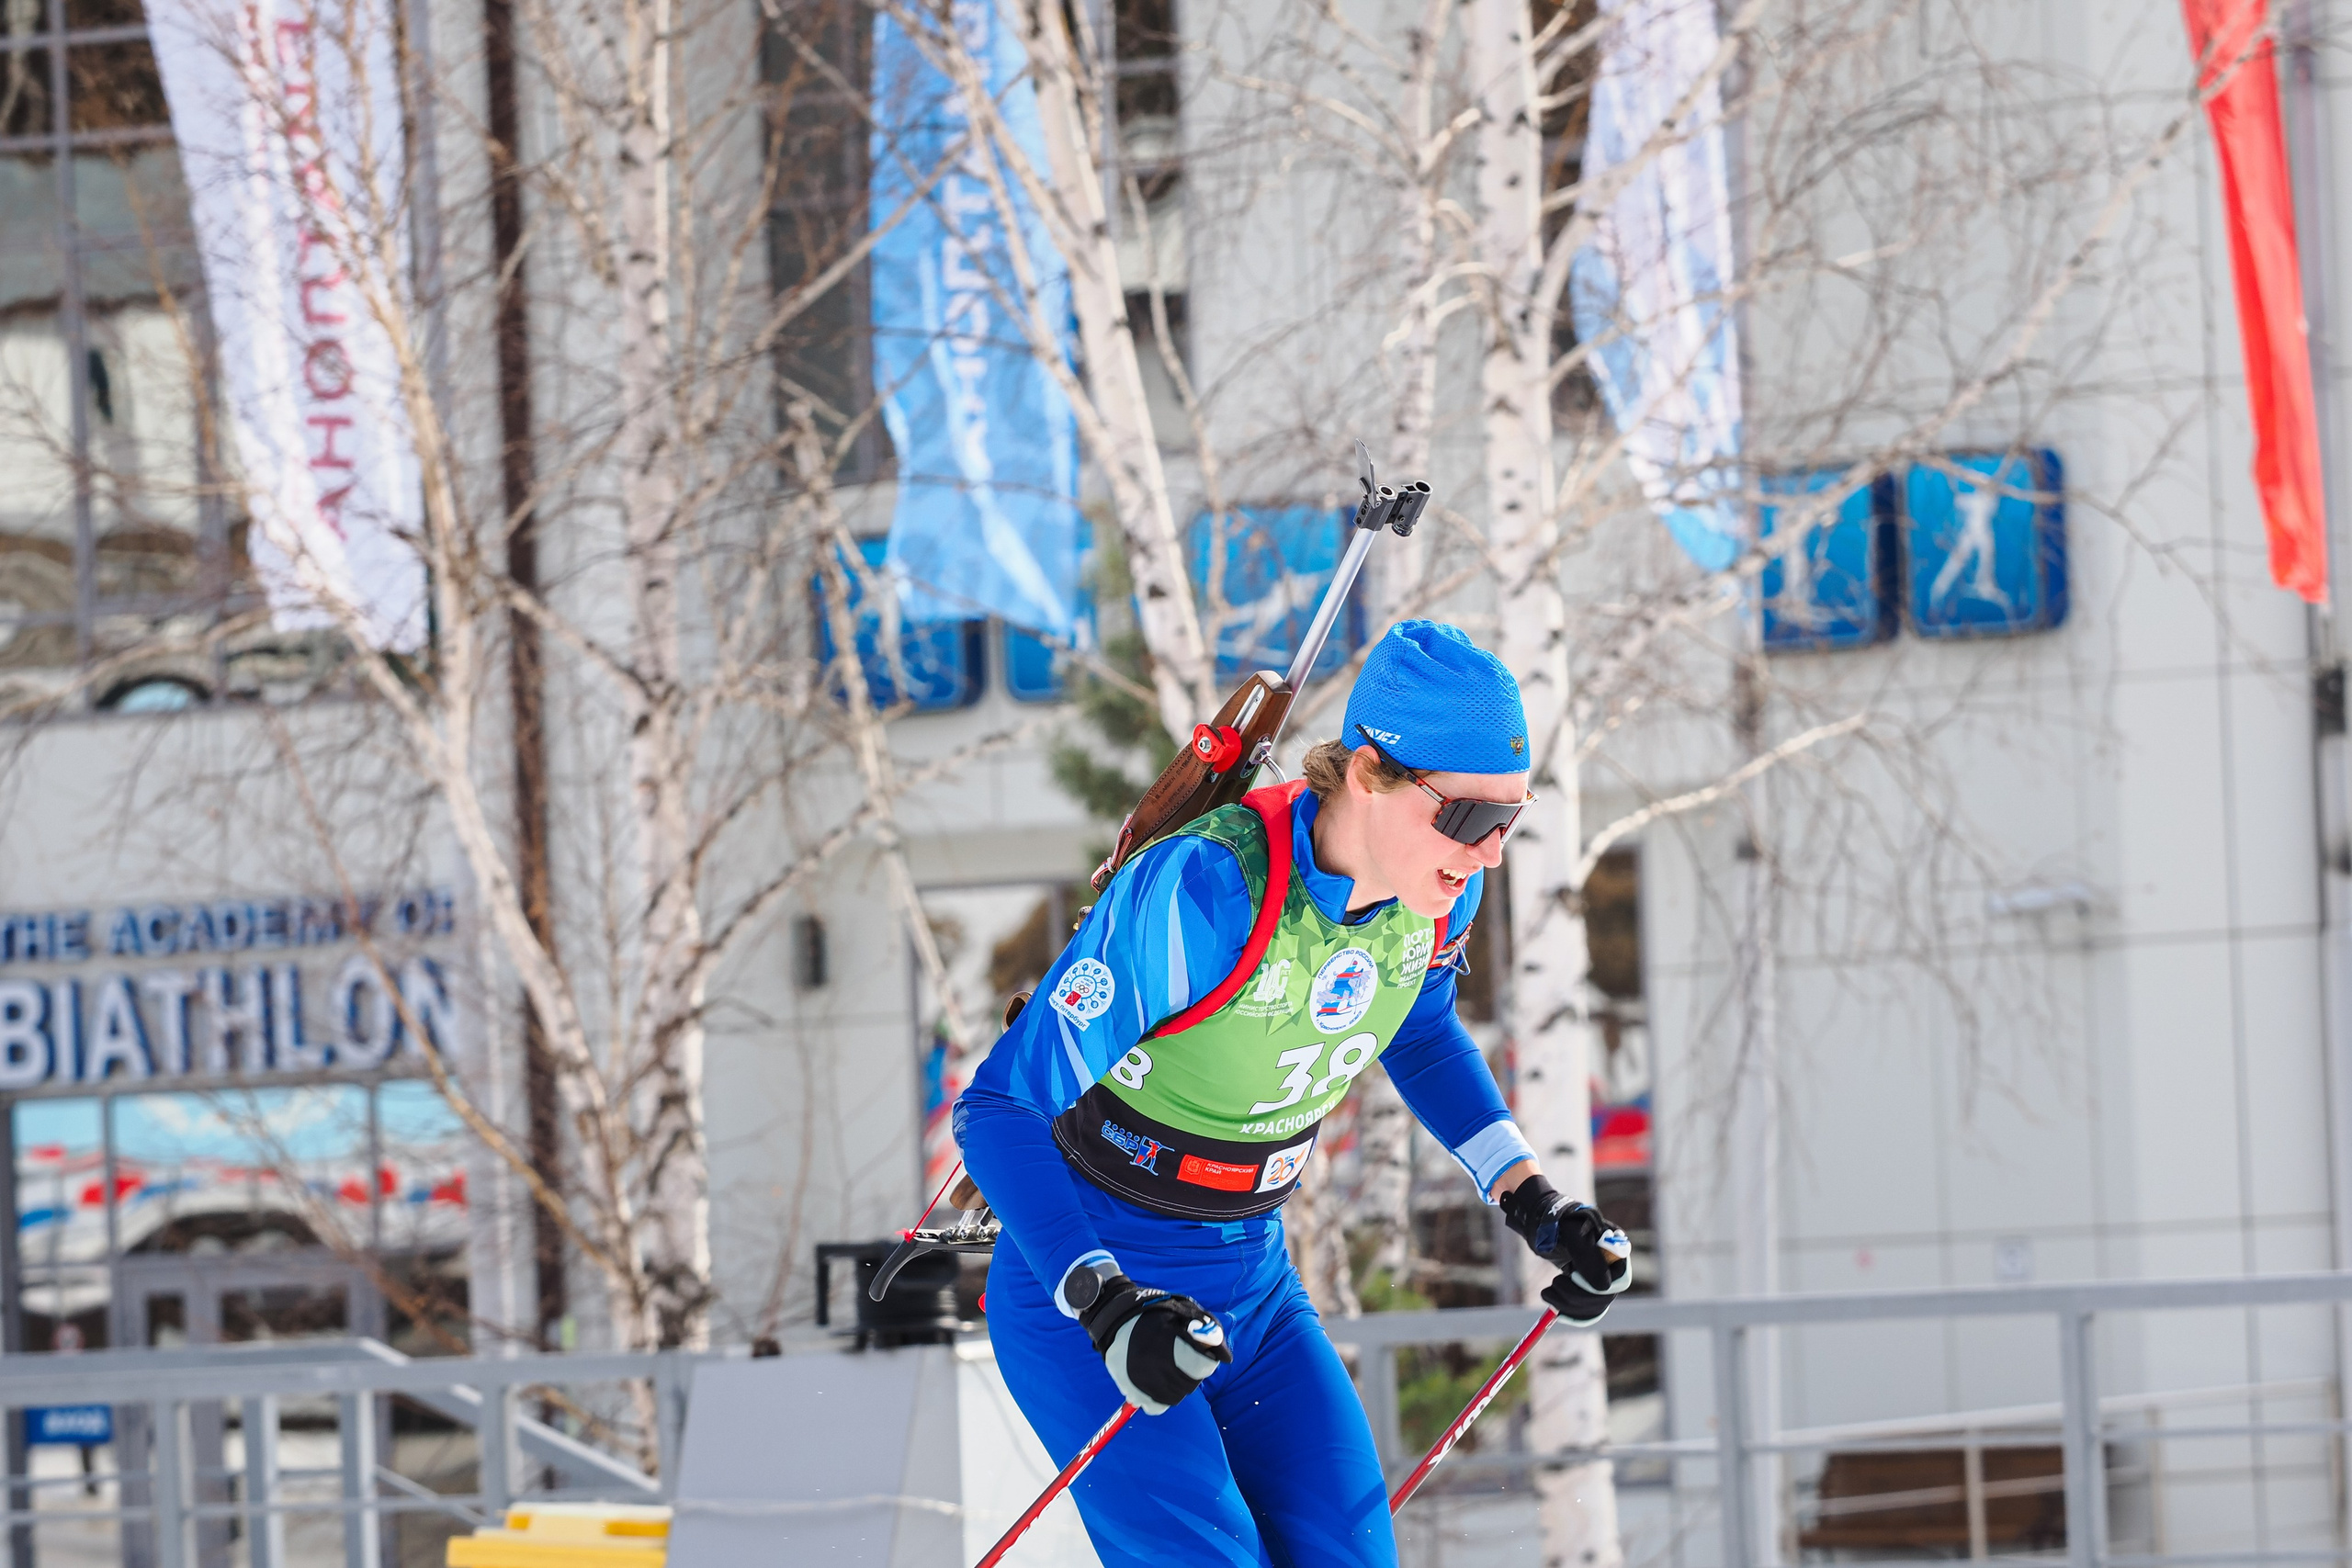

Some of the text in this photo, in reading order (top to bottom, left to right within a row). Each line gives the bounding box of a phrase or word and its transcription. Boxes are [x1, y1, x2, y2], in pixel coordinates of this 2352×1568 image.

[1317, 949, 1354, 979] ПЕРВЕНСТВО
[0, 953, 459, 1091] BIATHLON
[1247, 1032, 1378, 1114] 38
[1204, 1167, 1222, 1175] КРАЙ
[1206, 1163, 1254, 1174] КРАСНОЯРСКИЙ
